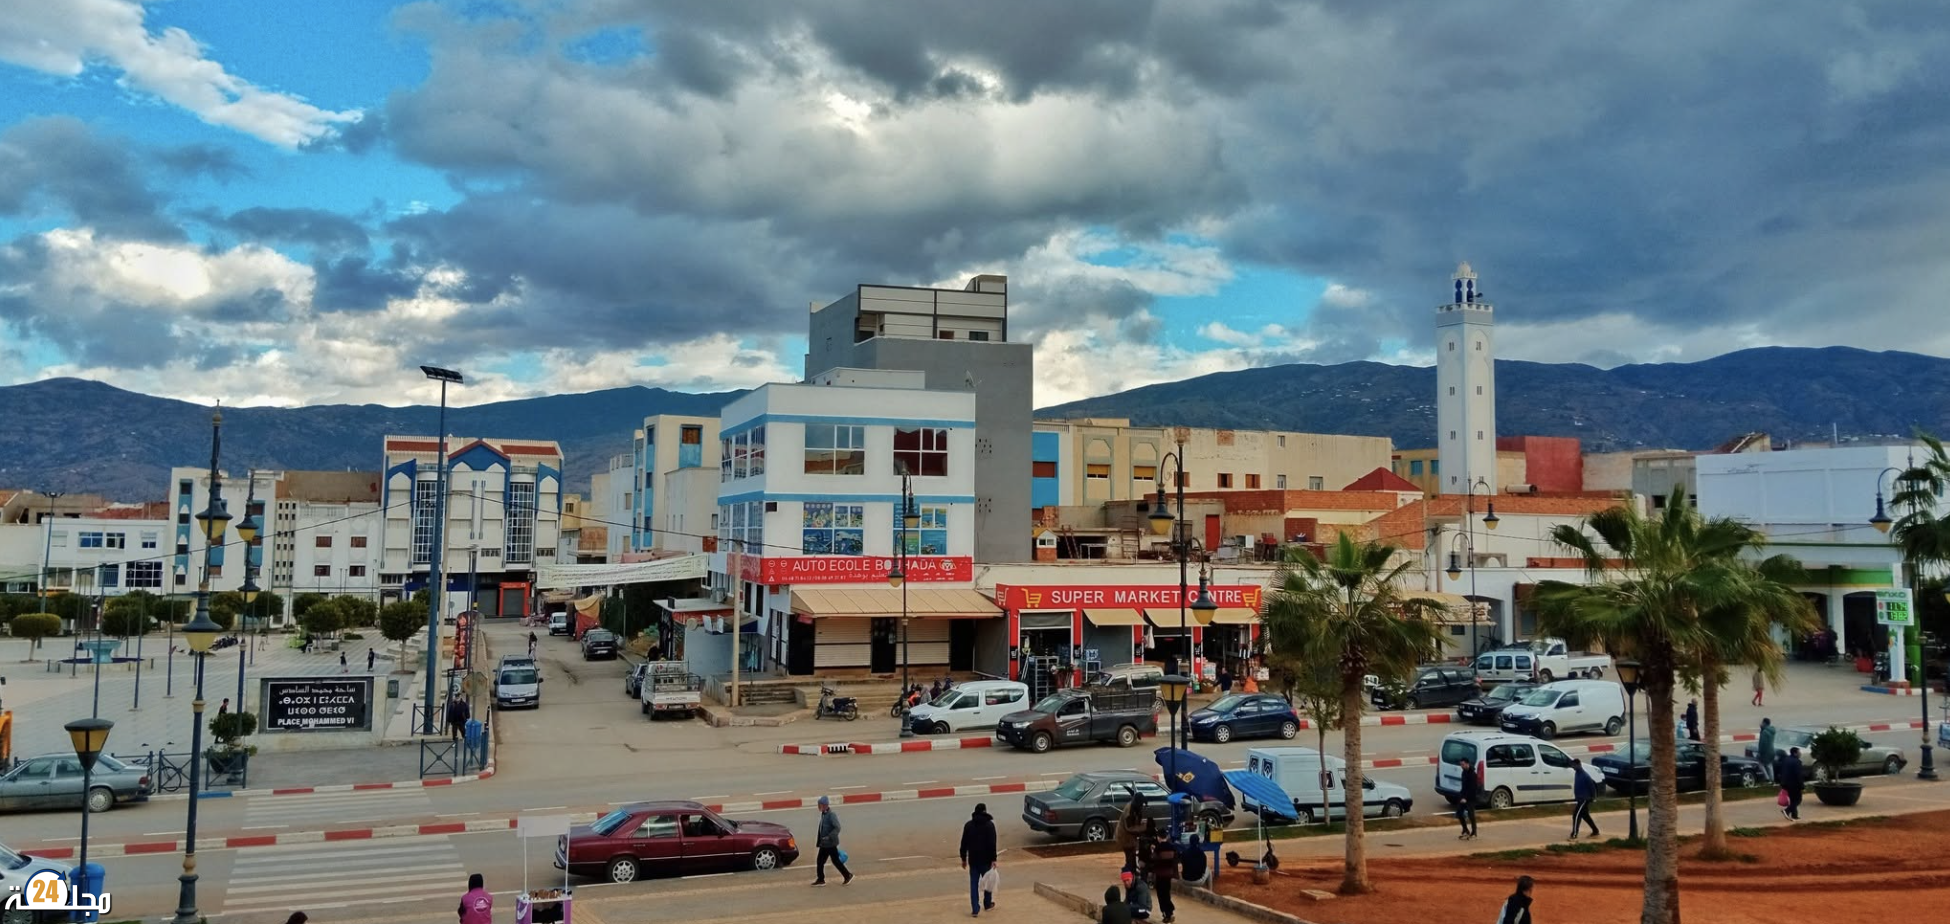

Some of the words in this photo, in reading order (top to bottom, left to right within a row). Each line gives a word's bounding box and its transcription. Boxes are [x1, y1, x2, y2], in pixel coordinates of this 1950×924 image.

[792, 559, 826, 572] AUTO
[829, 559, 871, 571] ECOLE
[1051, 590, 1104, 604] SUPER
[1114, 590, 1181, 604] MARKET
[1188, 590, 1242, 603] CNTRE
[279, 686, 310, 695] السادس
[311, 687, 333, 695] محمد
[334, 685, 356, 694] ساحة
[277, 718, 300, 726] PLACE
[302, 717, 346, 726] MOHAMMED
